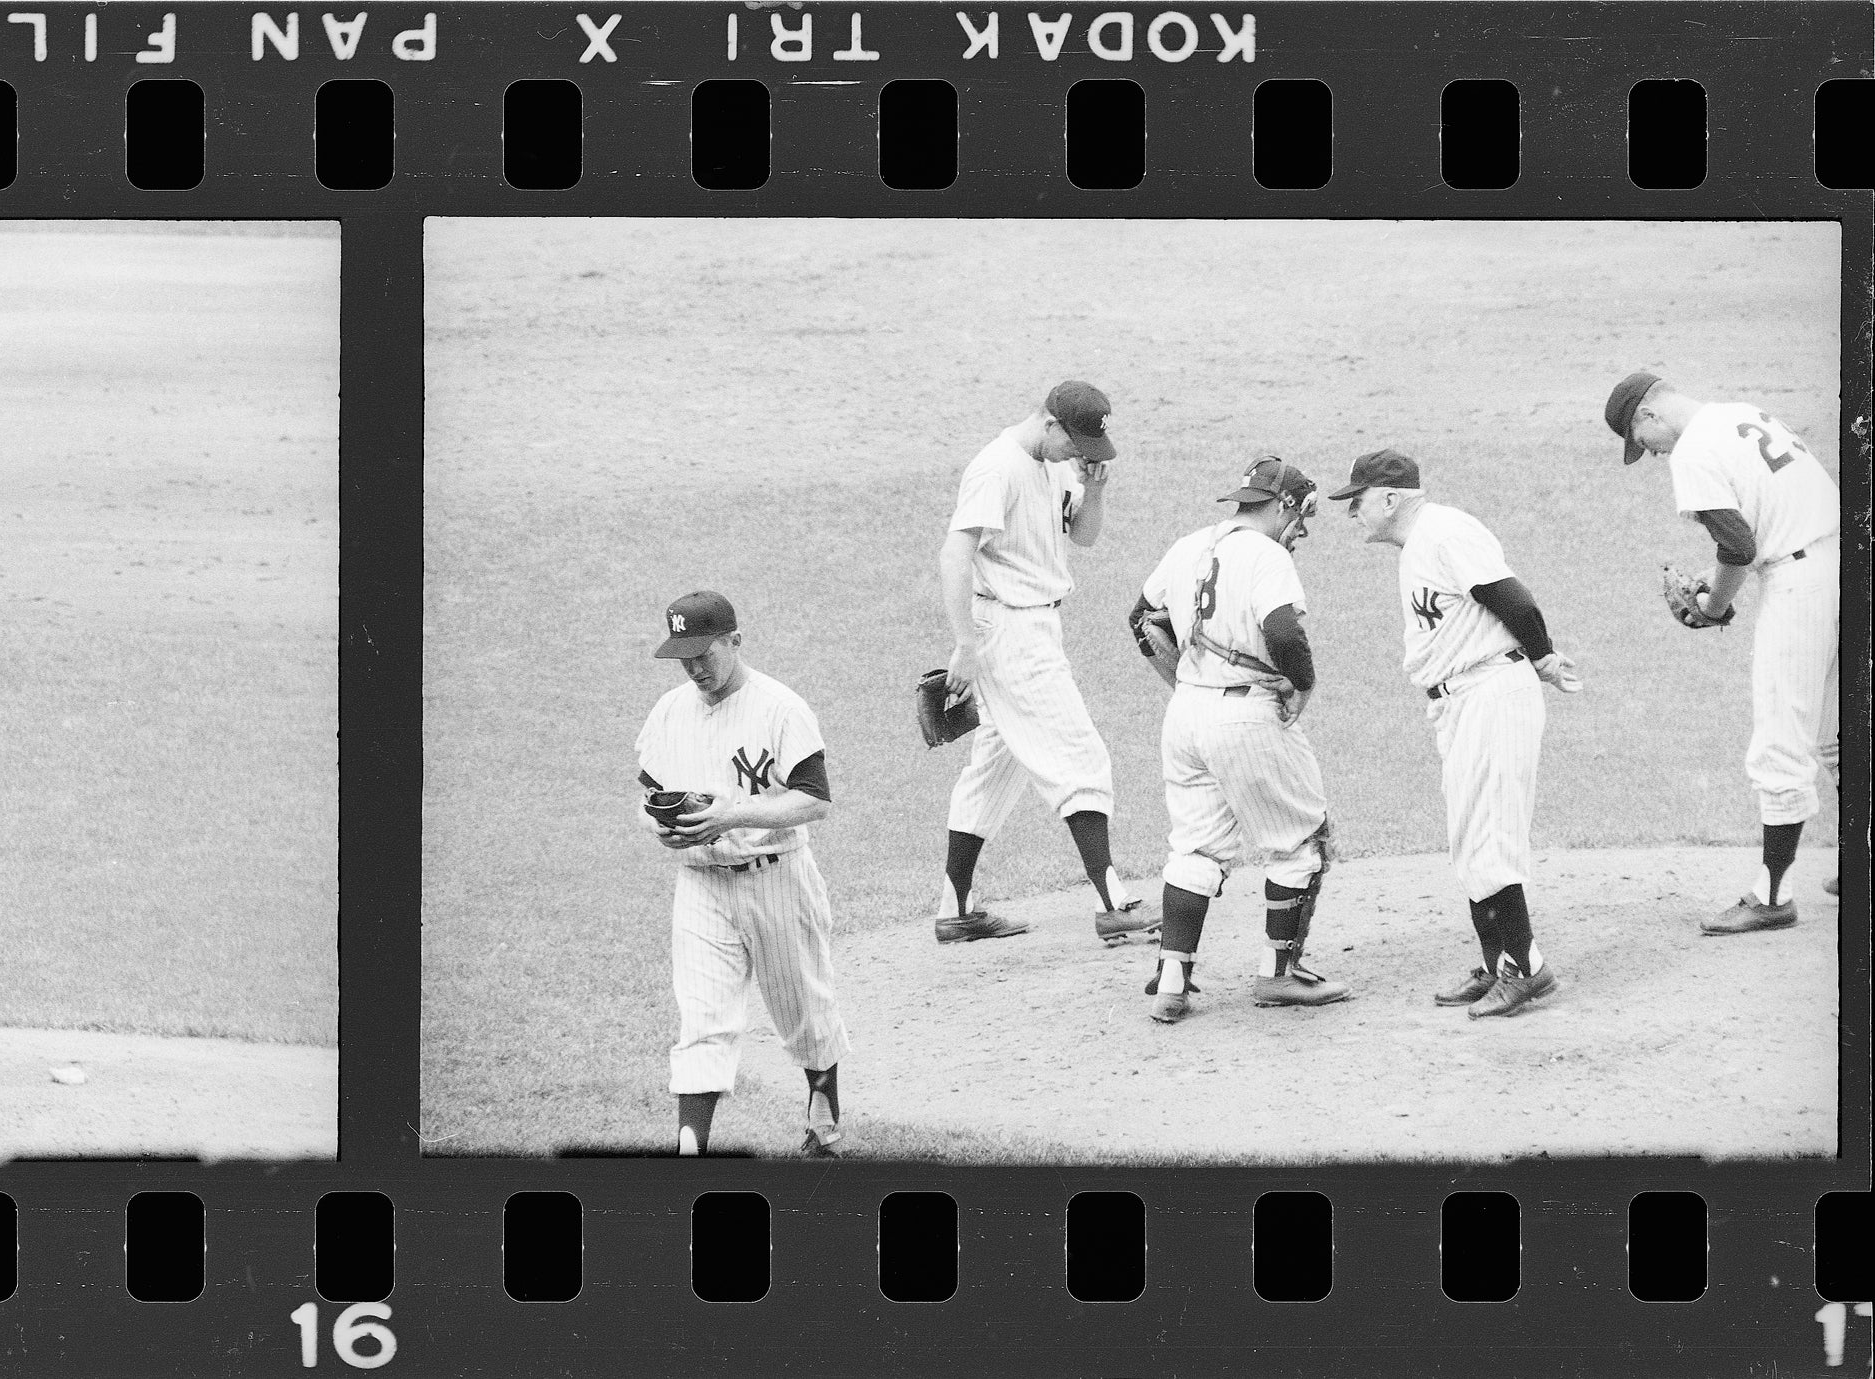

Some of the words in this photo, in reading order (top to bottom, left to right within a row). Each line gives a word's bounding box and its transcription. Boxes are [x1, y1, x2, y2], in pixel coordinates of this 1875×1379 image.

[252, 12, 436, 61] PAN
[577, 13, 621, 63] X
[727, 12, 879, 62] TRI
[957, 11, 1255, 63] KODAK
[291, 1300, 396, 1369] 16
